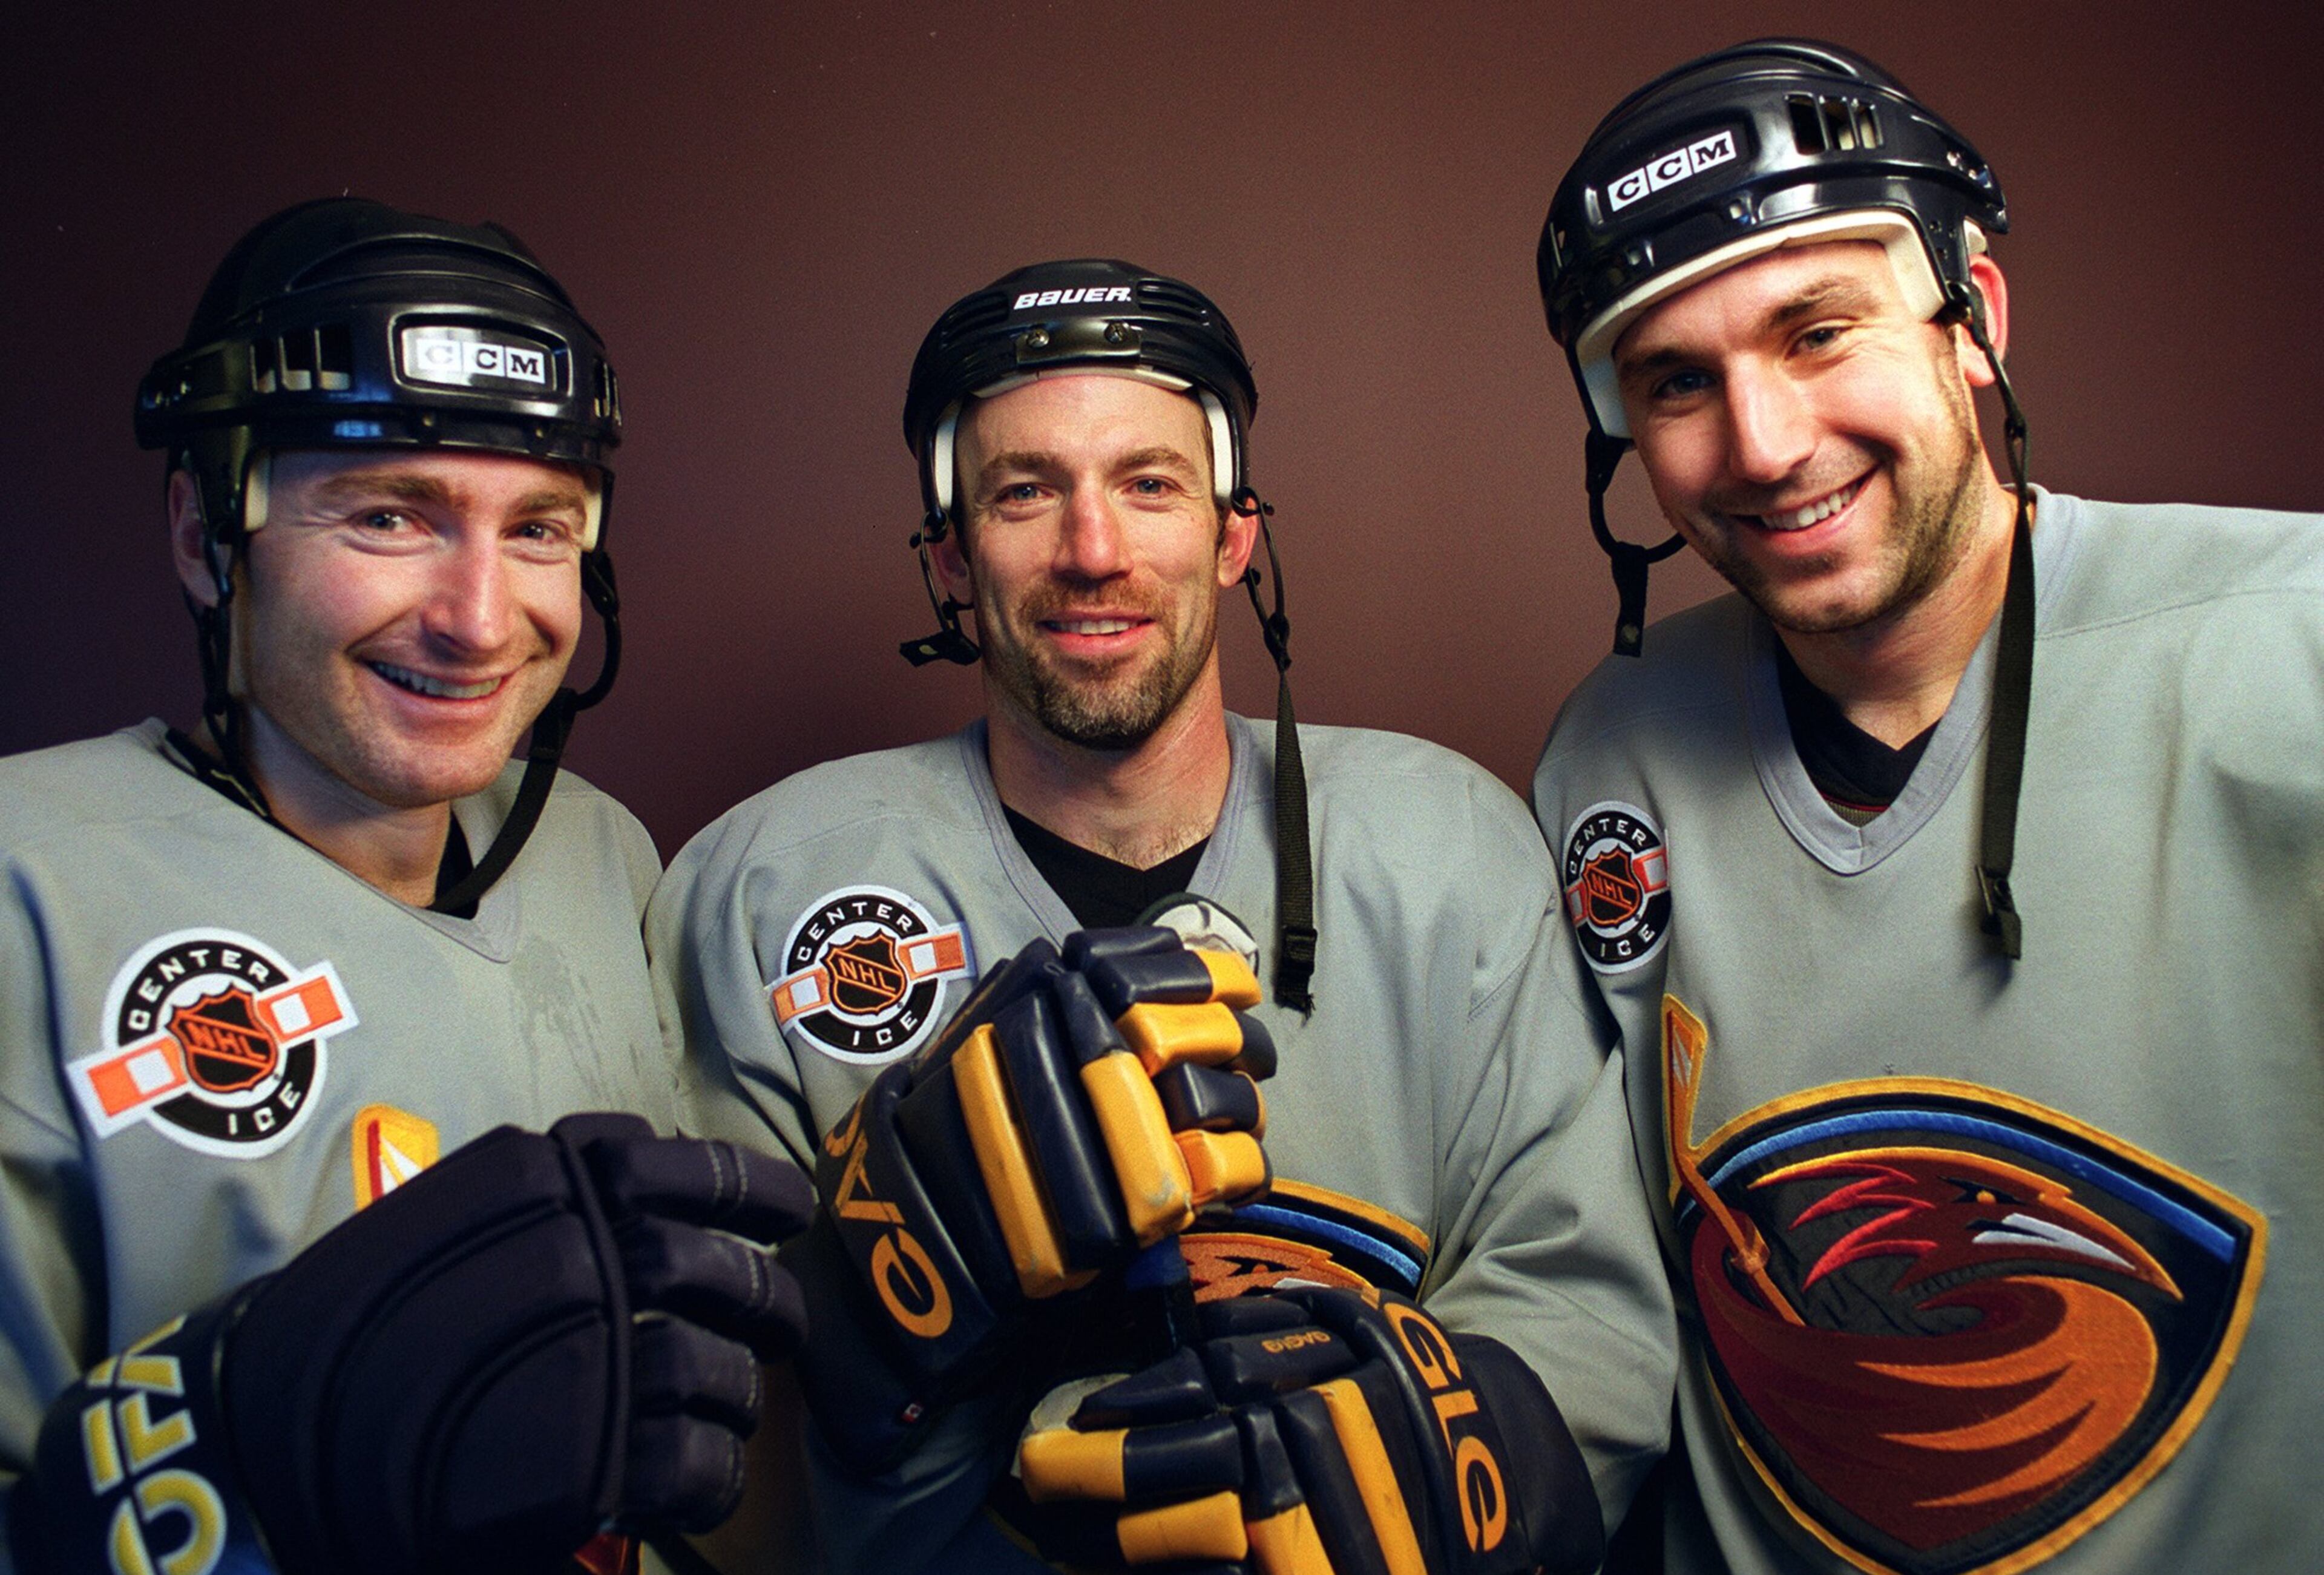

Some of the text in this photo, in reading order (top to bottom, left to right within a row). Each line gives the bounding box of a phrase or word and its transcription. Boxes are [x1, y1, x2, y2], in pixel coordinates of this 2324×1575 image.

[1616, 138, 1731, 201] CCM
[425, 345, 540, 377] CCM
[1569, 818, 1647, 875] CENTER
[1591, 872, 1632, 906] NHL
[796, 901, 914, 962] CENTER
[1600, 923, 1656, 958] ICE
[127, 949, 271, 1031] CENTER
[838, 958, 897, 993] NHL
[185, 1021, 268, 1062] NHL
[852, 1010, 919, 1047] ICE
[228, 1082, 302, 1136] ICE
[81, 1314, 228, 1575] OFA
